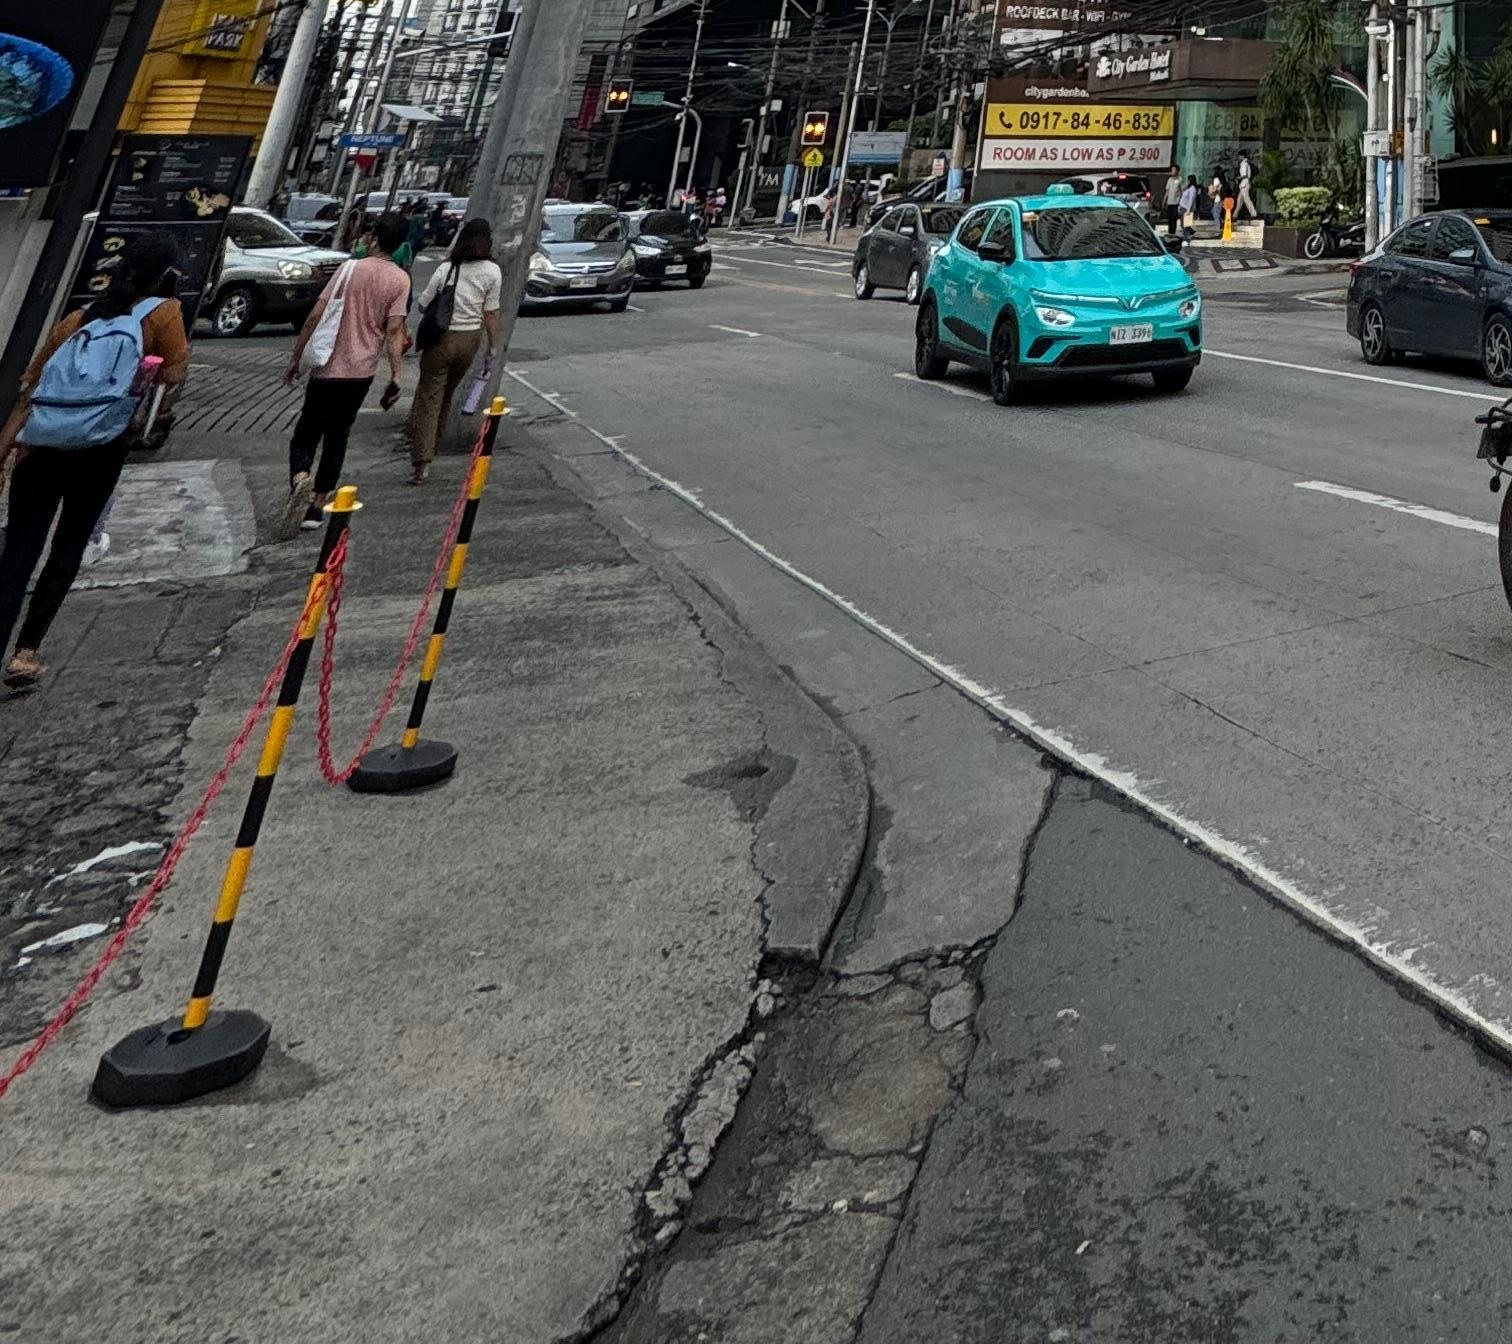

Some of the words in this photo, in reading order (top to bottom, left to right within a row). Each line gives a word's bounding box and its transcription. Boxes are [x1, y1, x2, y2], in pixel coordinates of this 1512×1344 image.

[1006, 5, 1059, 20] ROOFDECK
[1112, 57, 1125, 80] City
[1126, 53, 1149, 74] Garden
[1150, 50, 1171, 71] Hotel
[993, 147, 1036, 161] ROOM
[1039, 147, 1058, 161] AS
[1062, 147, 1094, 161] LOW
[1095, 147, 1113, 161] AS
[1128, 147, 1160, 162] 2,900
